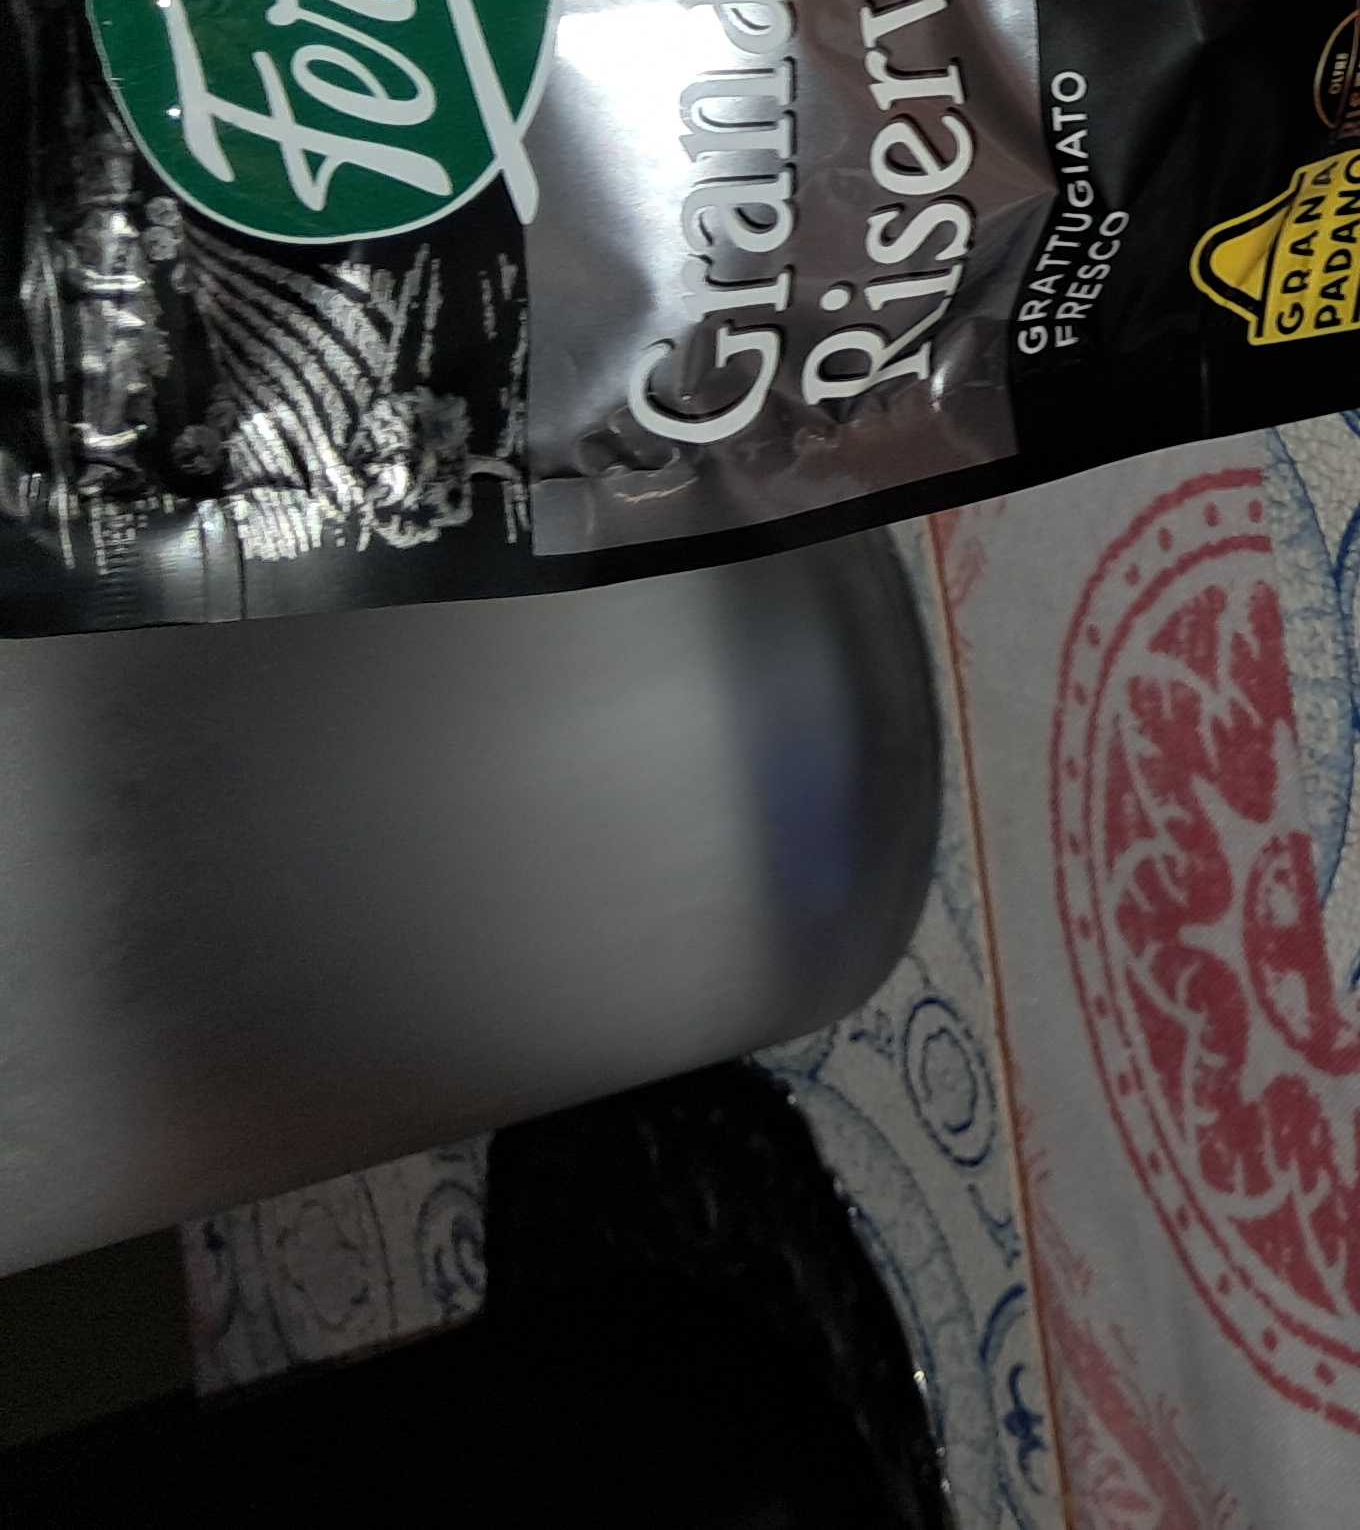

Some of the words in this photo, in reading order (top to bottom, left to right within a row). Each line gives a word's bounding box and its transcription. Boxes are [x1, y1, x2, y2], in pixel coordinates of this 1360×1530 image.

[1017, 71, 1094, 354] GRATTUGIATO
[1054, 211, 1130, 348] FRESCO
[1276, 161, 1338, 335] GRANA
